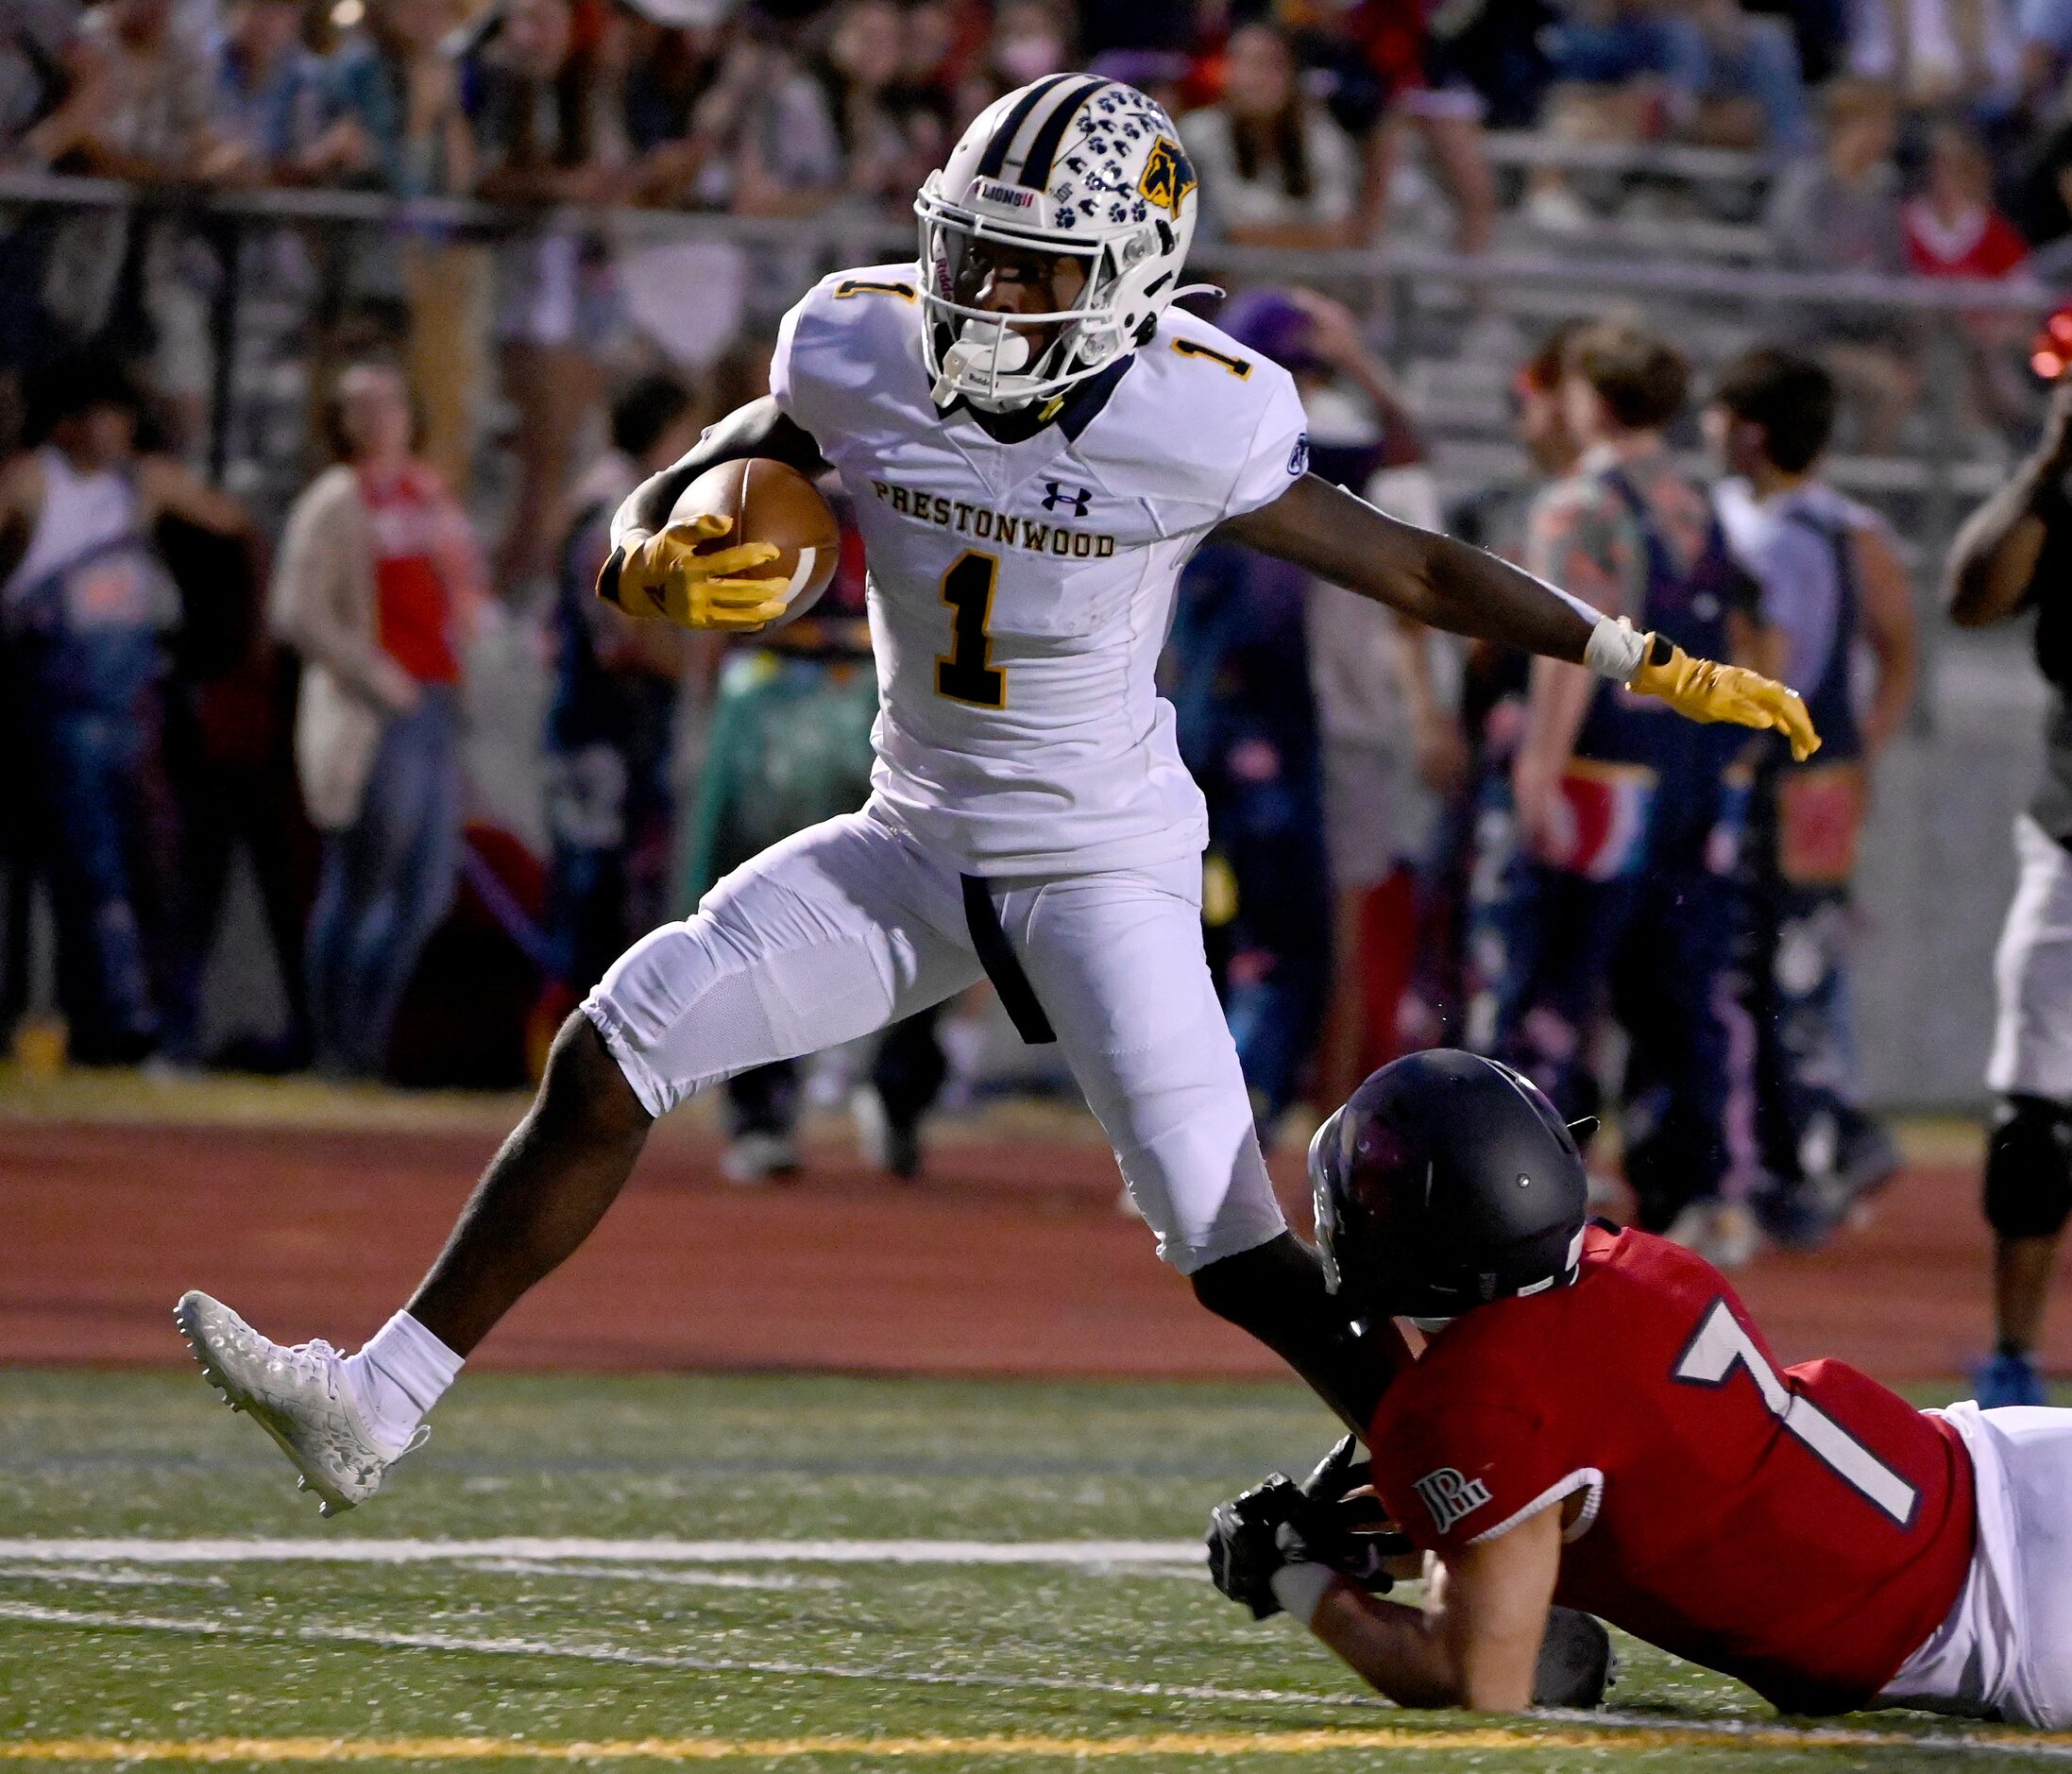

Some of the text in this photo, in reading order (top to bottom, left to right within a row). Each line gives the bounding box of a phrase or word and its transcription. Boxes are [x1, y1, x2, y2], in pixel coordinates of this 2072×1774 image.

[982, 183, 1023, 207] LIONS
[834, 280, 919, 306] 1
[1170, 336, 1254, 383] 1
[872, 480, 1115, 558] PRESTONWOOD
[934, 548, 1008, 711] 1
[1671, 1295, 1922, 1533] 7
